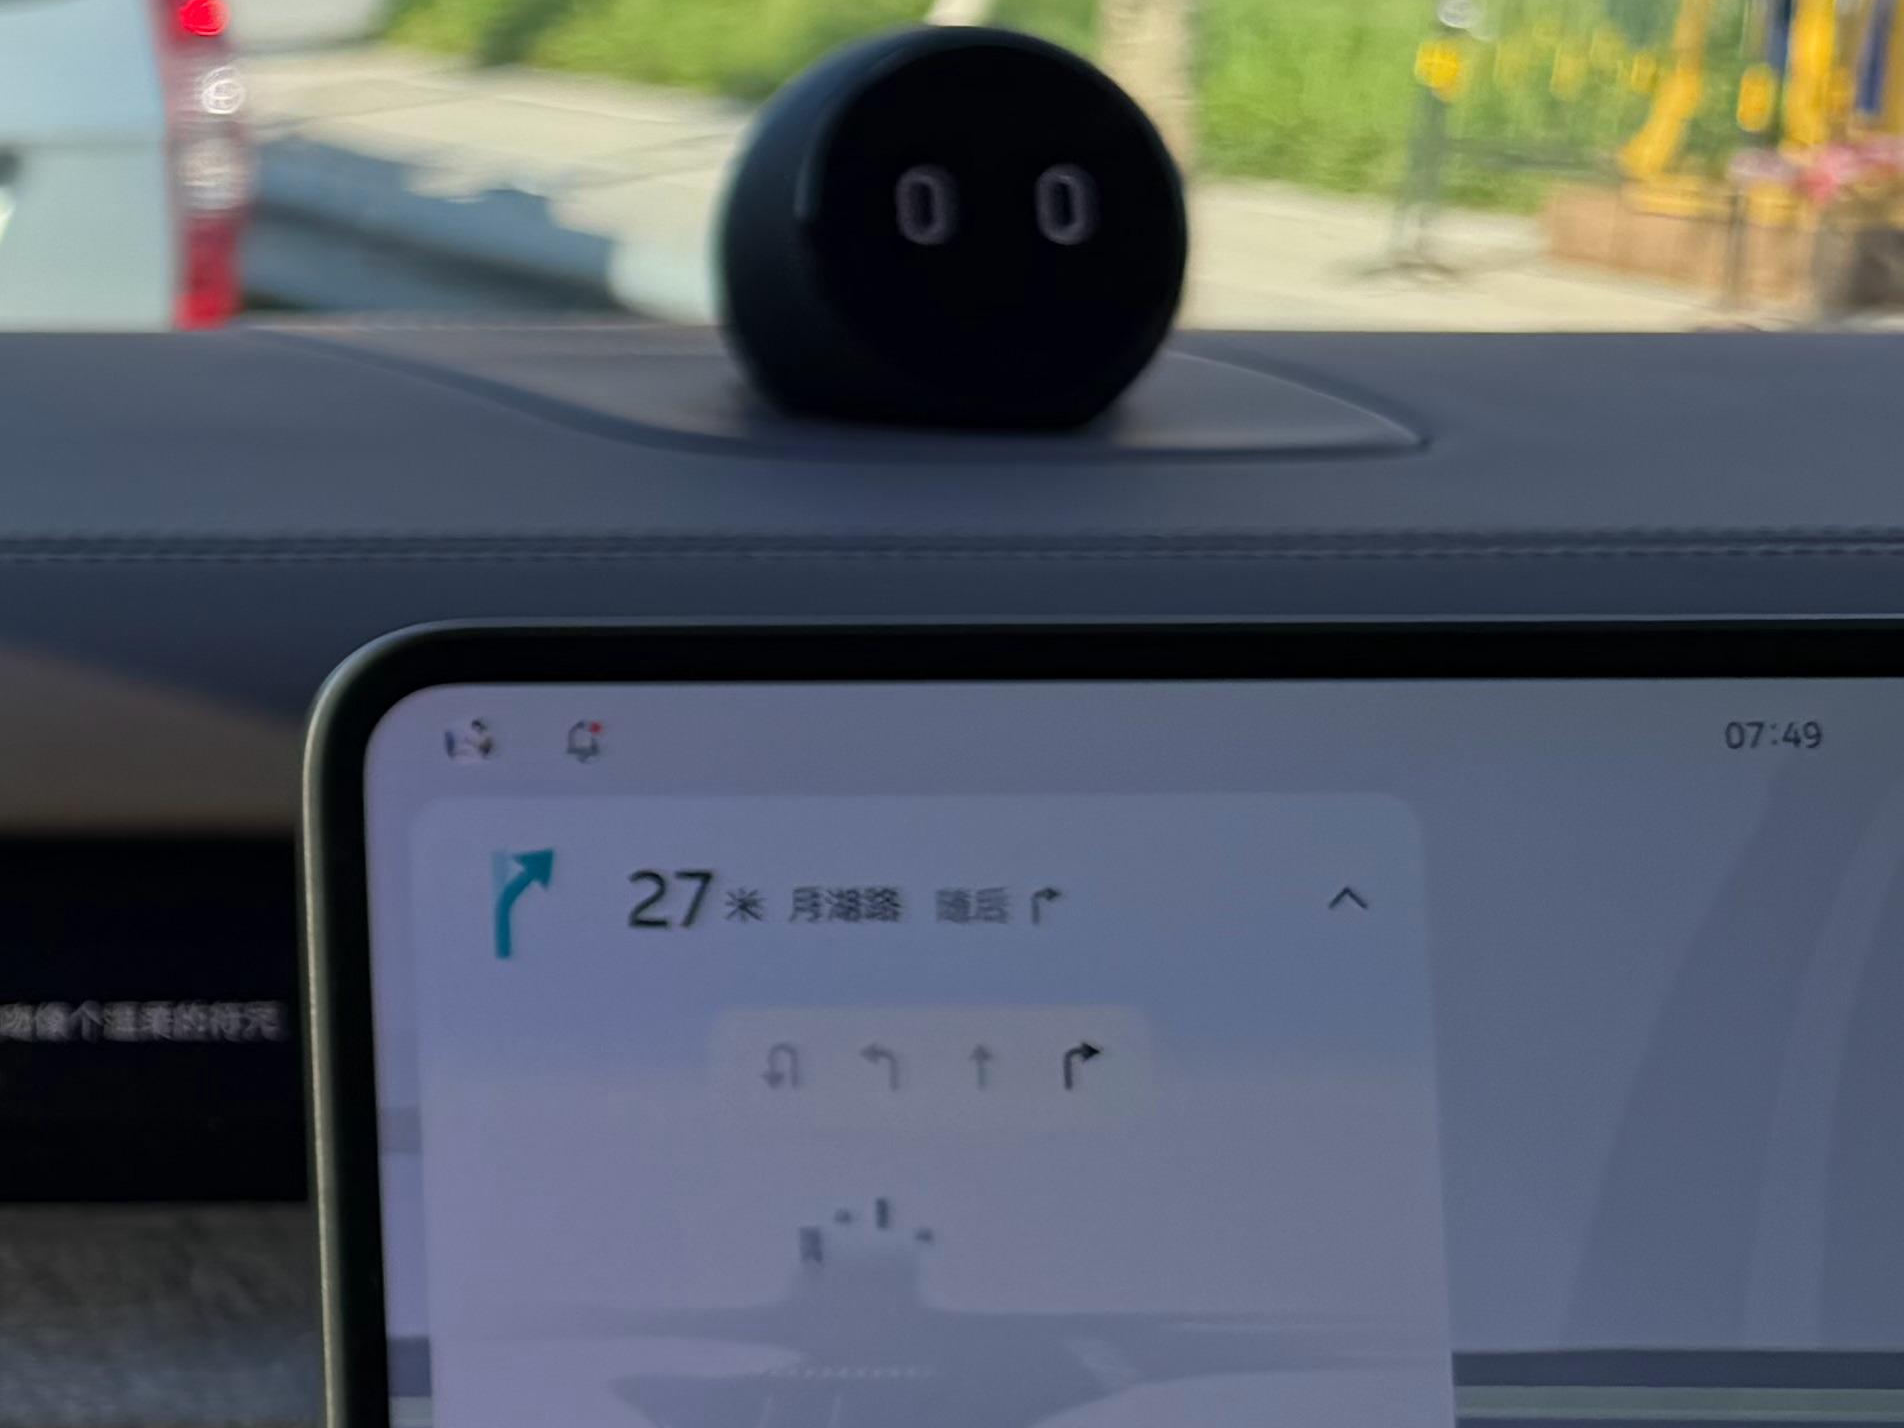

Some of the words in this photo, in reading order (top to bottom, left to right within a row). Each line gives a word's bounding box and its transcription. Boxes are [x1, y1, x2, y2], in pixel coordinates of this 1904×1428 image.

[1724, 721, 1823, 750] 07:49
[629, 871, 713, 928] 27
[724, 887, 764, 923] 米
[792, 887, 903, 924] 月湖路
